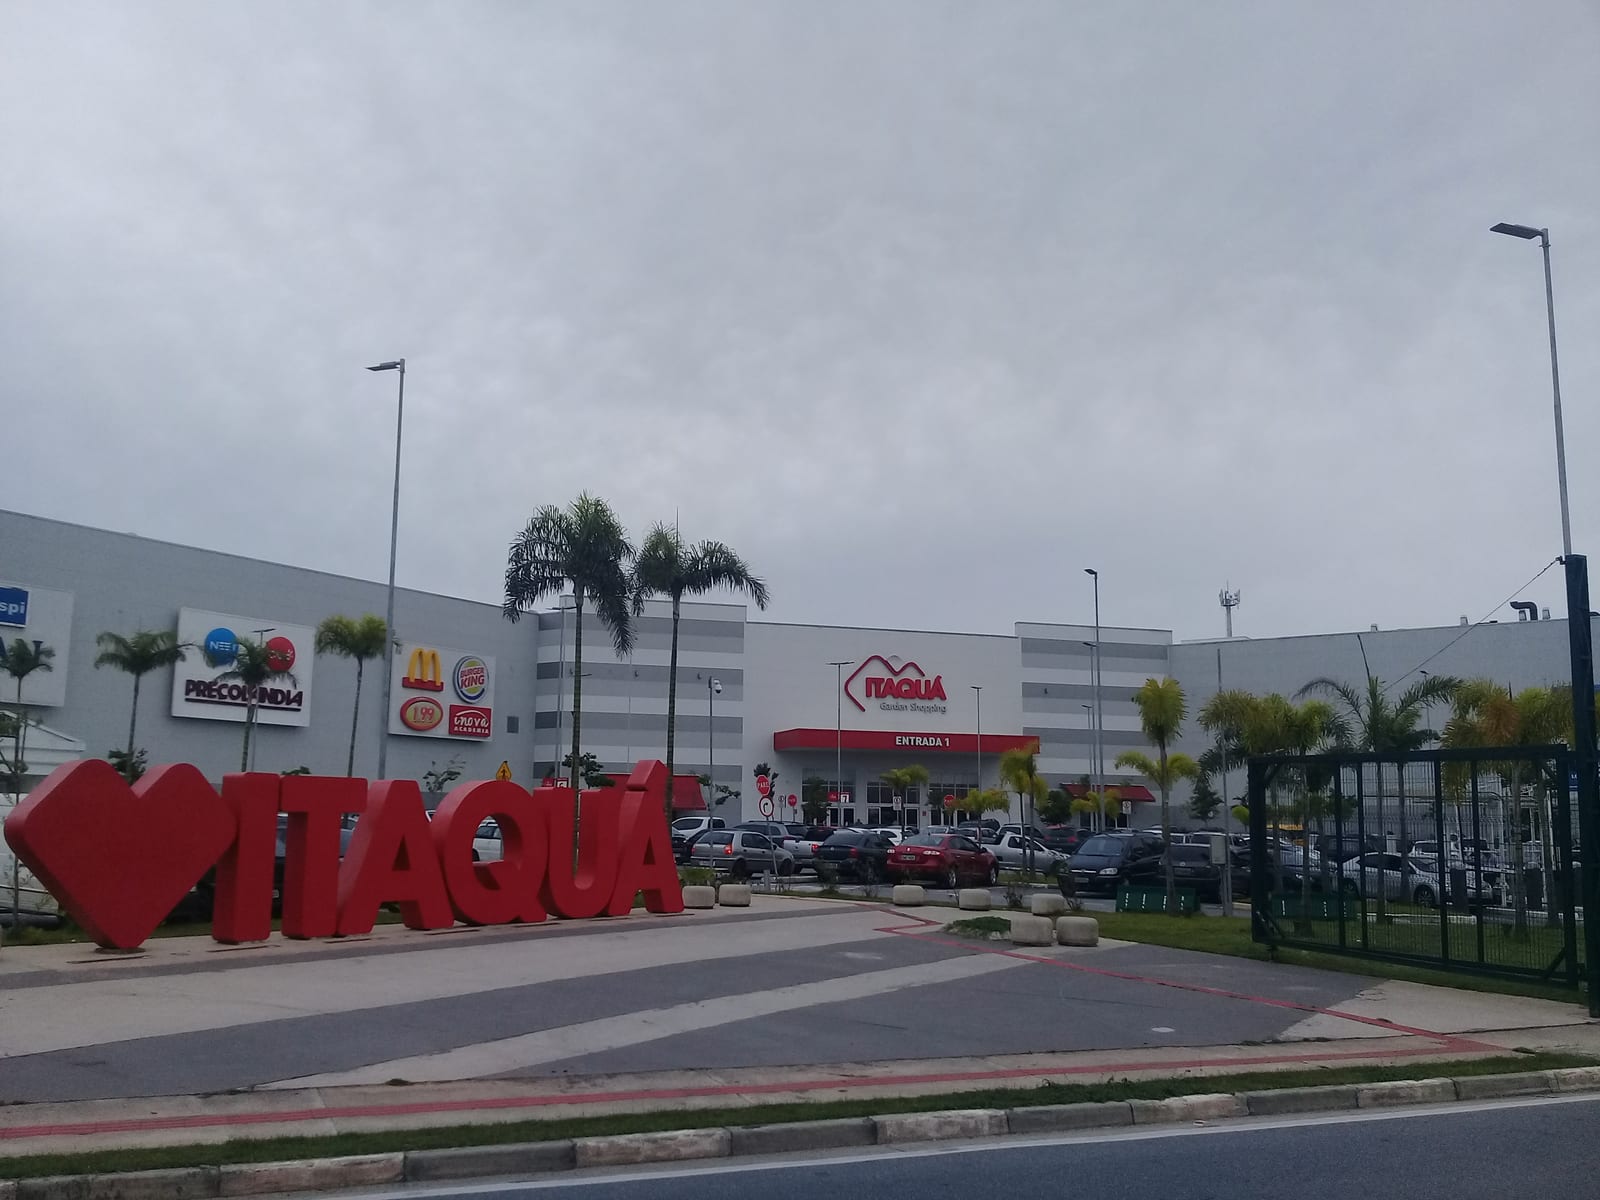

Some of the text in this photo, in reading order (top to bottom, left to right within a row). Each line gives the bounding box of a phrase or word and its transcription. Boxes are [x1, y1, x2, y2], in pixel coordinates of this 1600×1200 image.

[460, 668, 484, 678] BURGER
[460, 675, 485, 689] KING
[865, 674, 948, 701] ITAQUÁ
[880, 702, 947, 714] Garden Shopping
[895, 736, 950, 747] ENTRADA 1
[212, 759, 684, 945] ITAQUÁ
